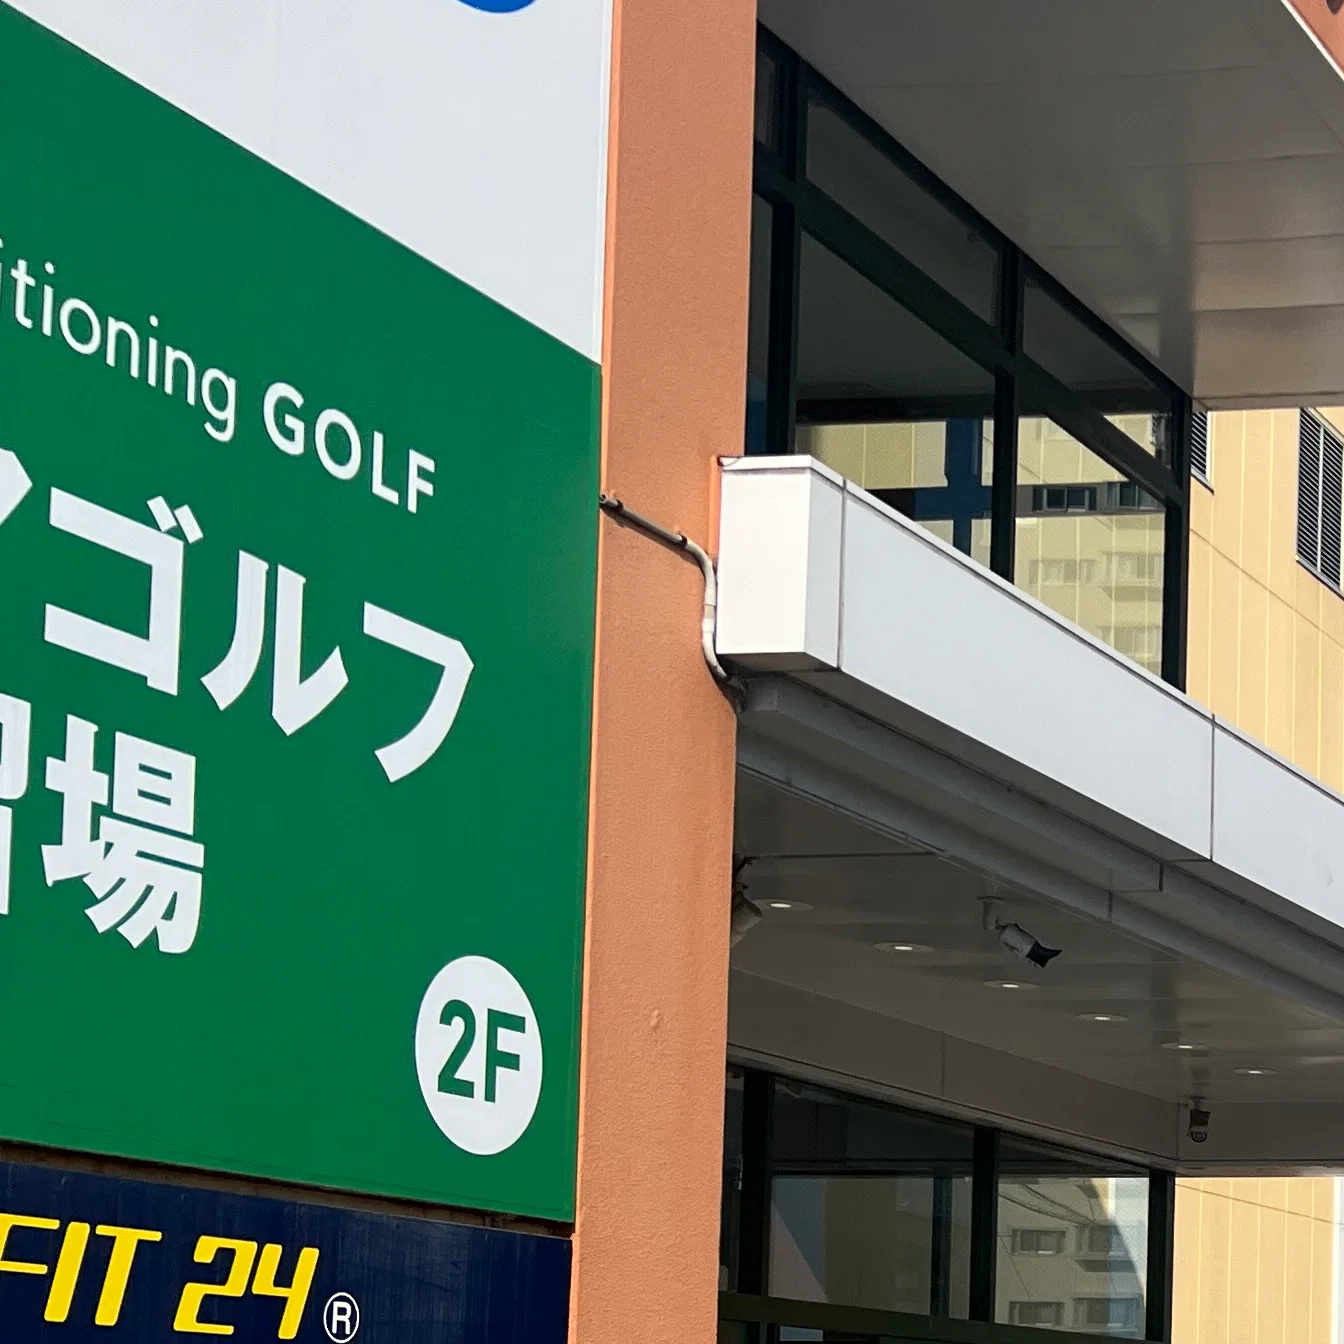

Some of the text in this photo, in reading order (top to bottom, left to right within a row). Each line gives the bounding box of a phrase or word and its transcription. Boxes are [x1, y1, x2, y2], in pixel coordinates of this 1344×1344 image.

[0, 237, 437, 515] tioning GOLF
[0, 447, 474, 783] ゴルフ
[437, 998, 527, 1104] 2F
[173, 1235, 320, 1340] 24
